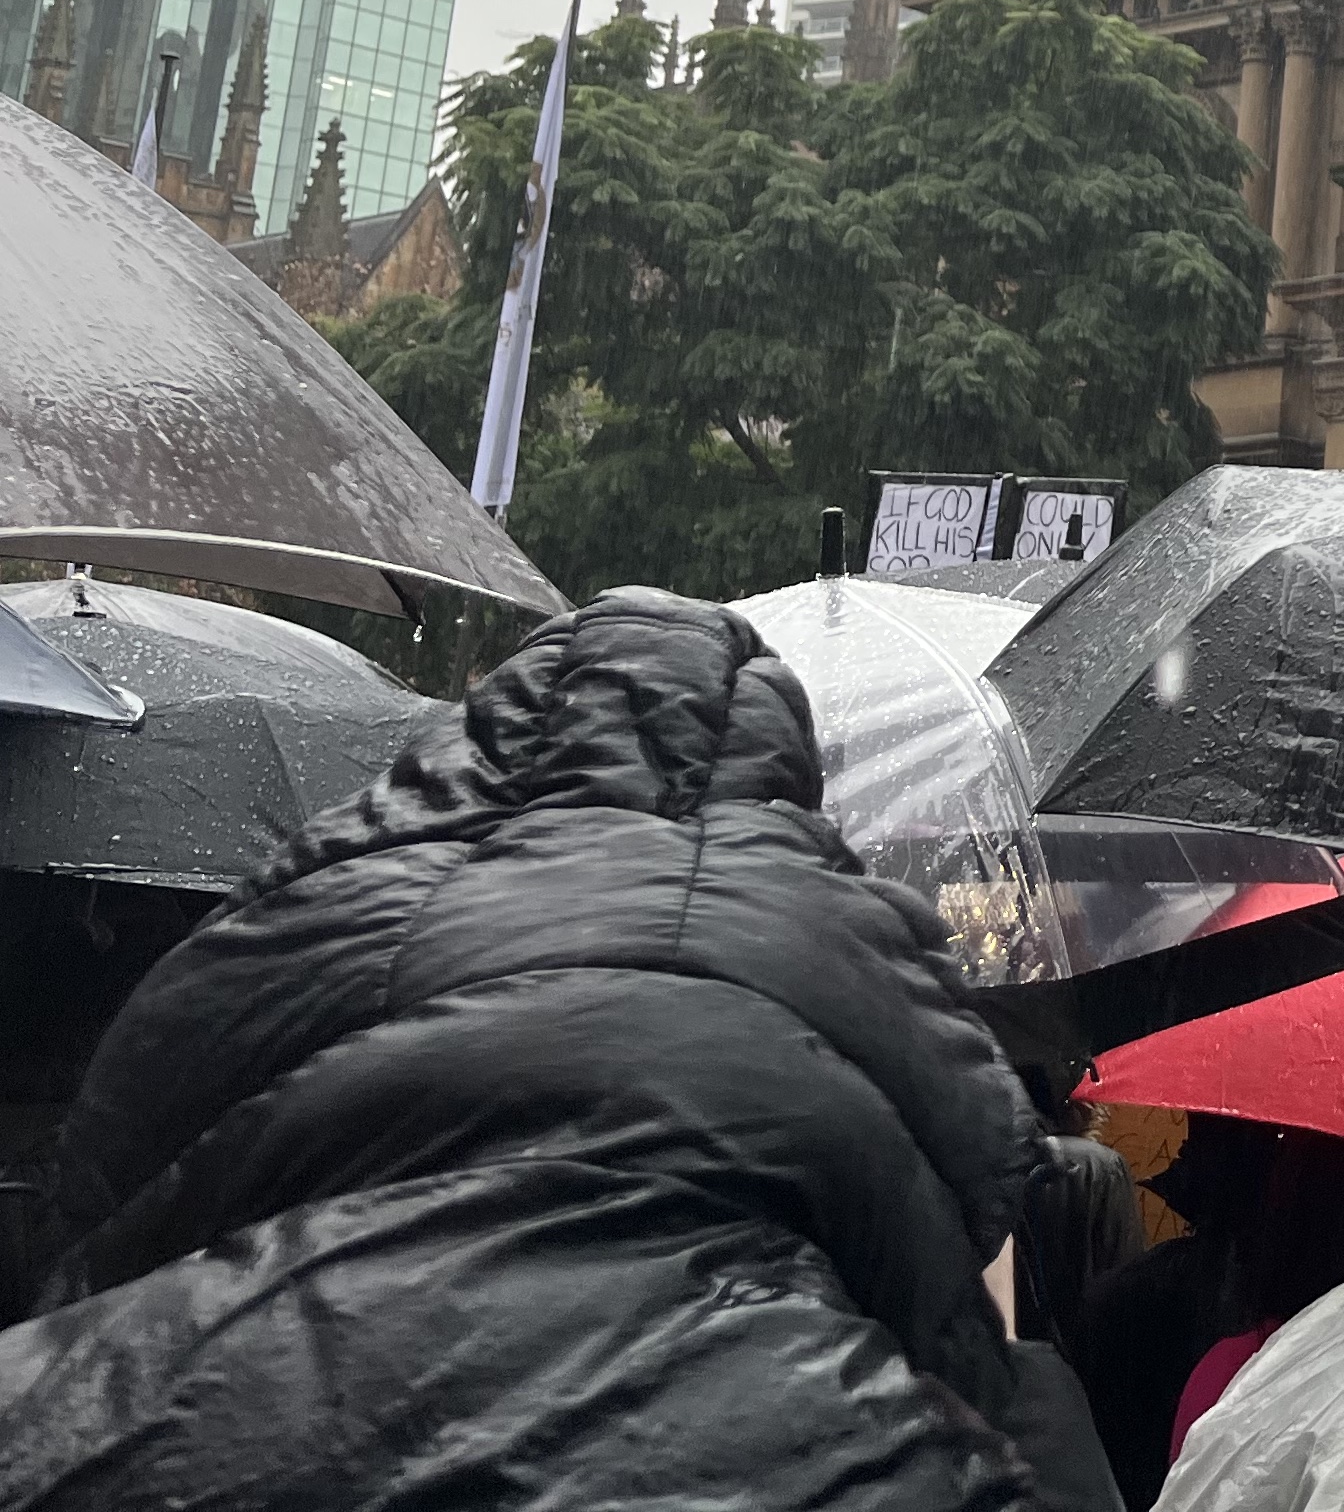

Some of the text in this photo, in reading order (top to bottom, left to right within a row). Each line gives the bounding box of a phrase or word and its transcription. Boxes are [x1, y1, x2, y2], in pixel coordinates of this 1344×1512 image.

[882, 486, 972, 522] IF GOD
[1027, 494, 1113, 528] COULD
[875, 520, 976, 559] KILL HIS
